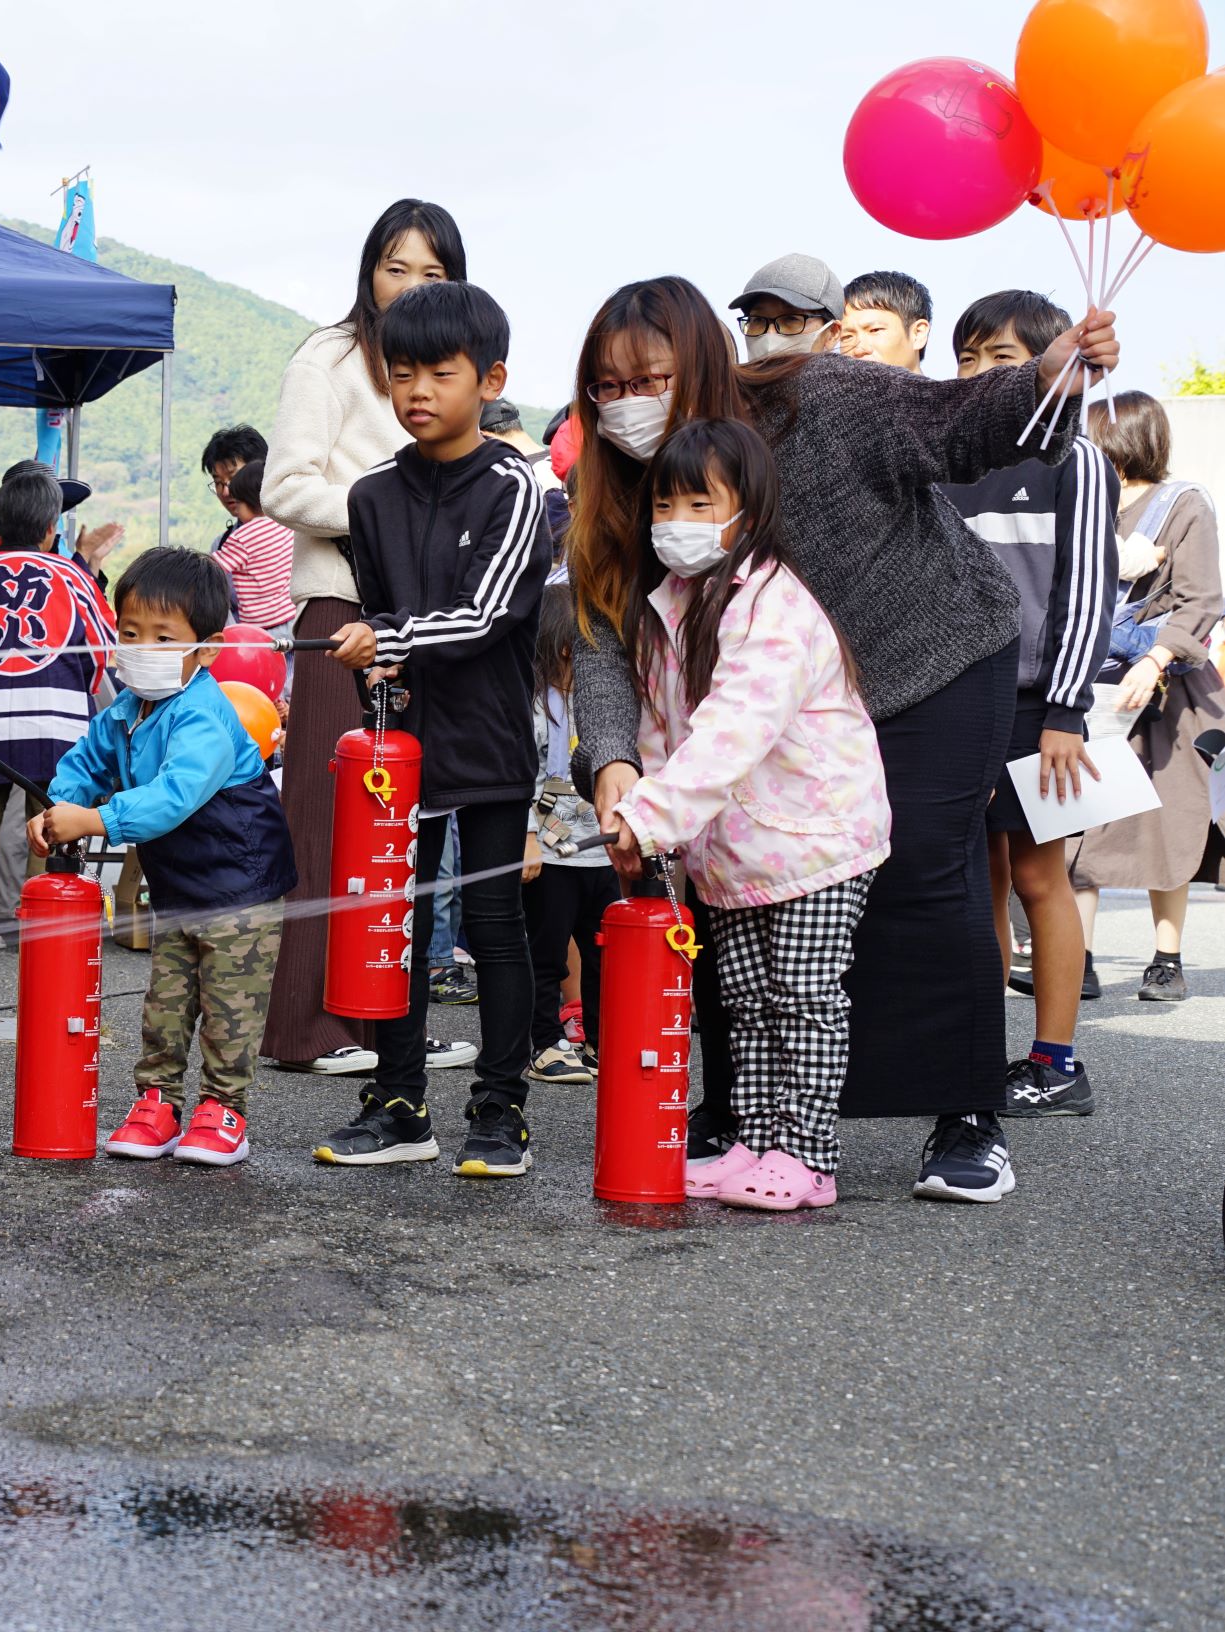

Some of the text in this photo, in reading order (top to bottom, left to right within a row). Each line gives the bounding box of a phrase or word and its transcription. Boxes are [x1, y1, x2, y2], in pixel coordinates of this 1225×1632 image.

[388, 806, 395, 819] 1
[385, 843, 395, 856] 2
[383, 878, 392, 891] 3
[381, 913, 391, 925] 4
[380, 949, 389, 961] 5
[676, 975, 682, 989] 1
[674, 1014, 682, 1027] 2
[672, 1052, 681, 1065] 3
[671, 1089, 680, 1102] 4
[670, 1128, 678, 1141] 5
